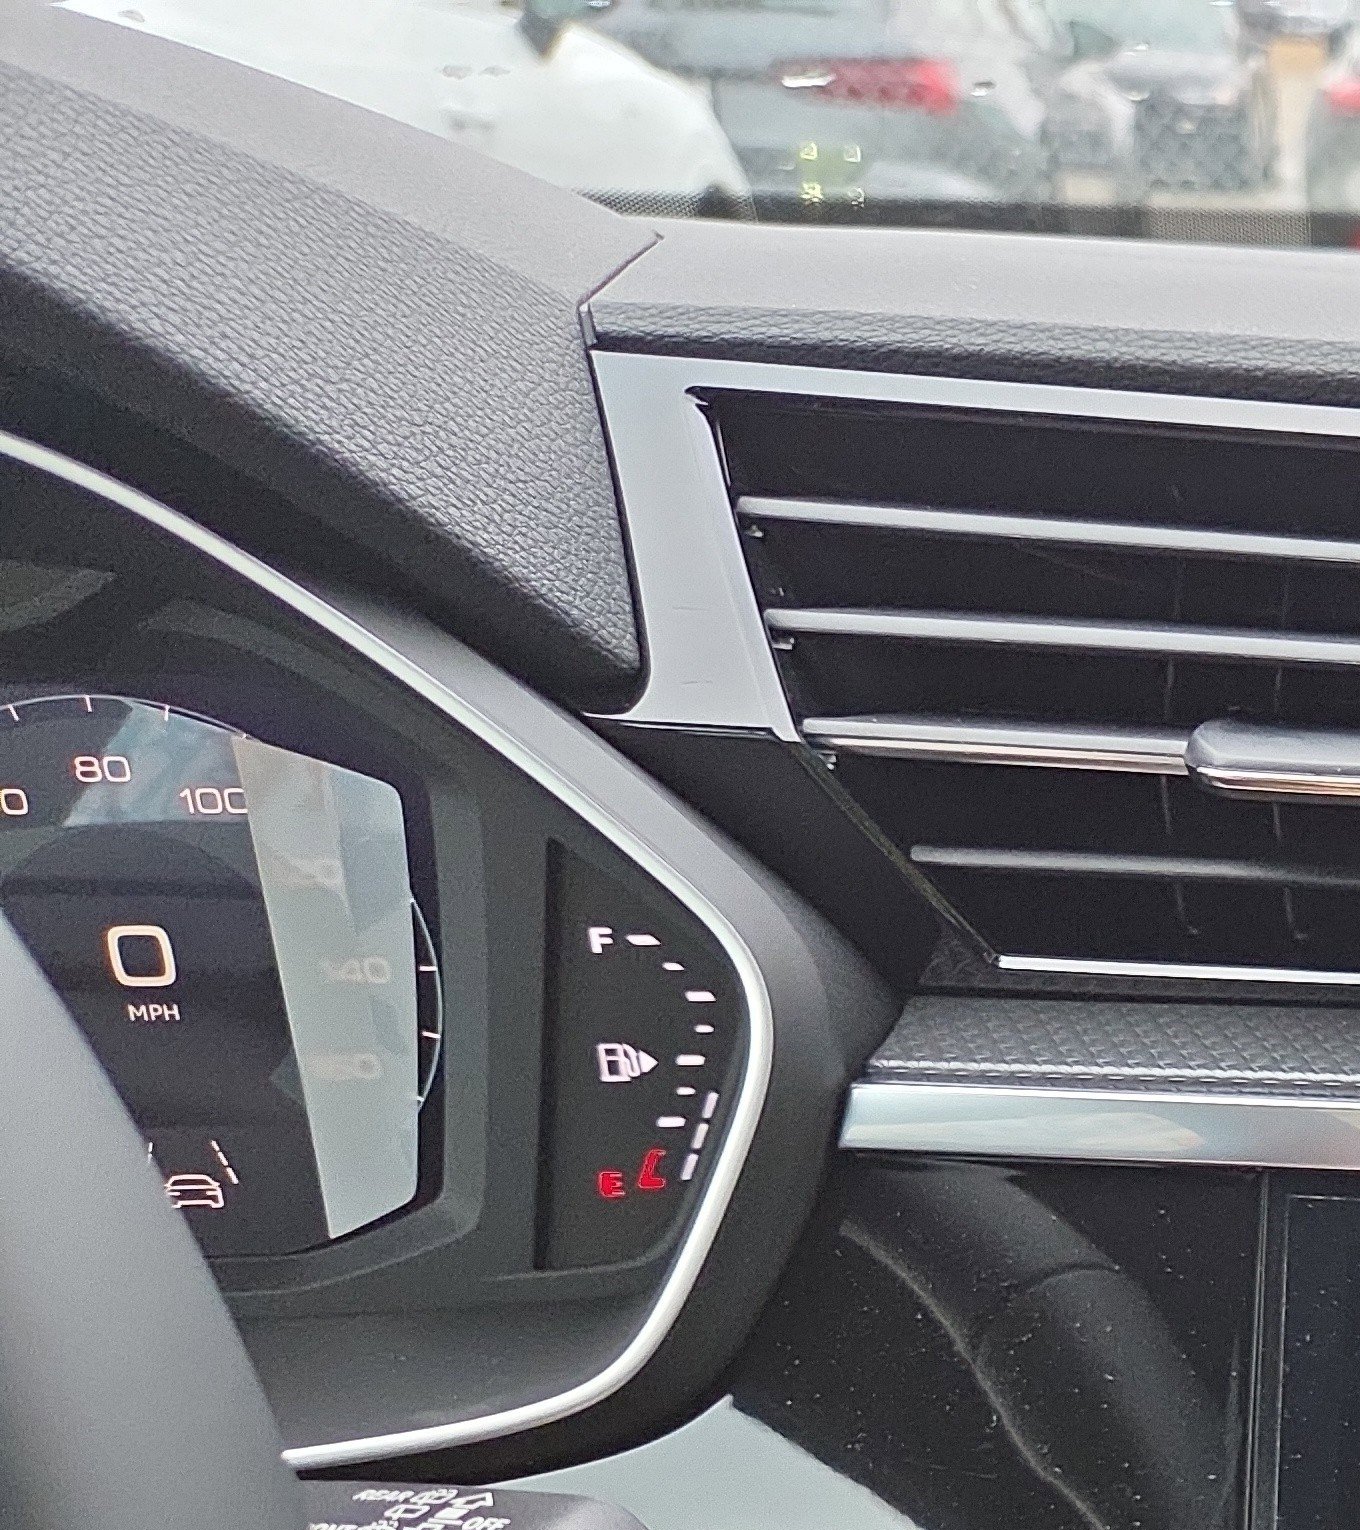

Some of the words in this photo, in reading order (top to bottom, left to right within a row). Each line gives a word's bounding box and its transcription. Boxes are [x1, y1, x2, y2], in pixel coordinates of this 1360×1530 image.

[73, 754, 132, 783] 80
[586, 925, 614, 955] F
[106, 923, 178, 988] 0
[126, 1002, 182, 1022] MPH
[596, 1169, 627, 1199] E
[351, 1488, 415, 1502] REAR
